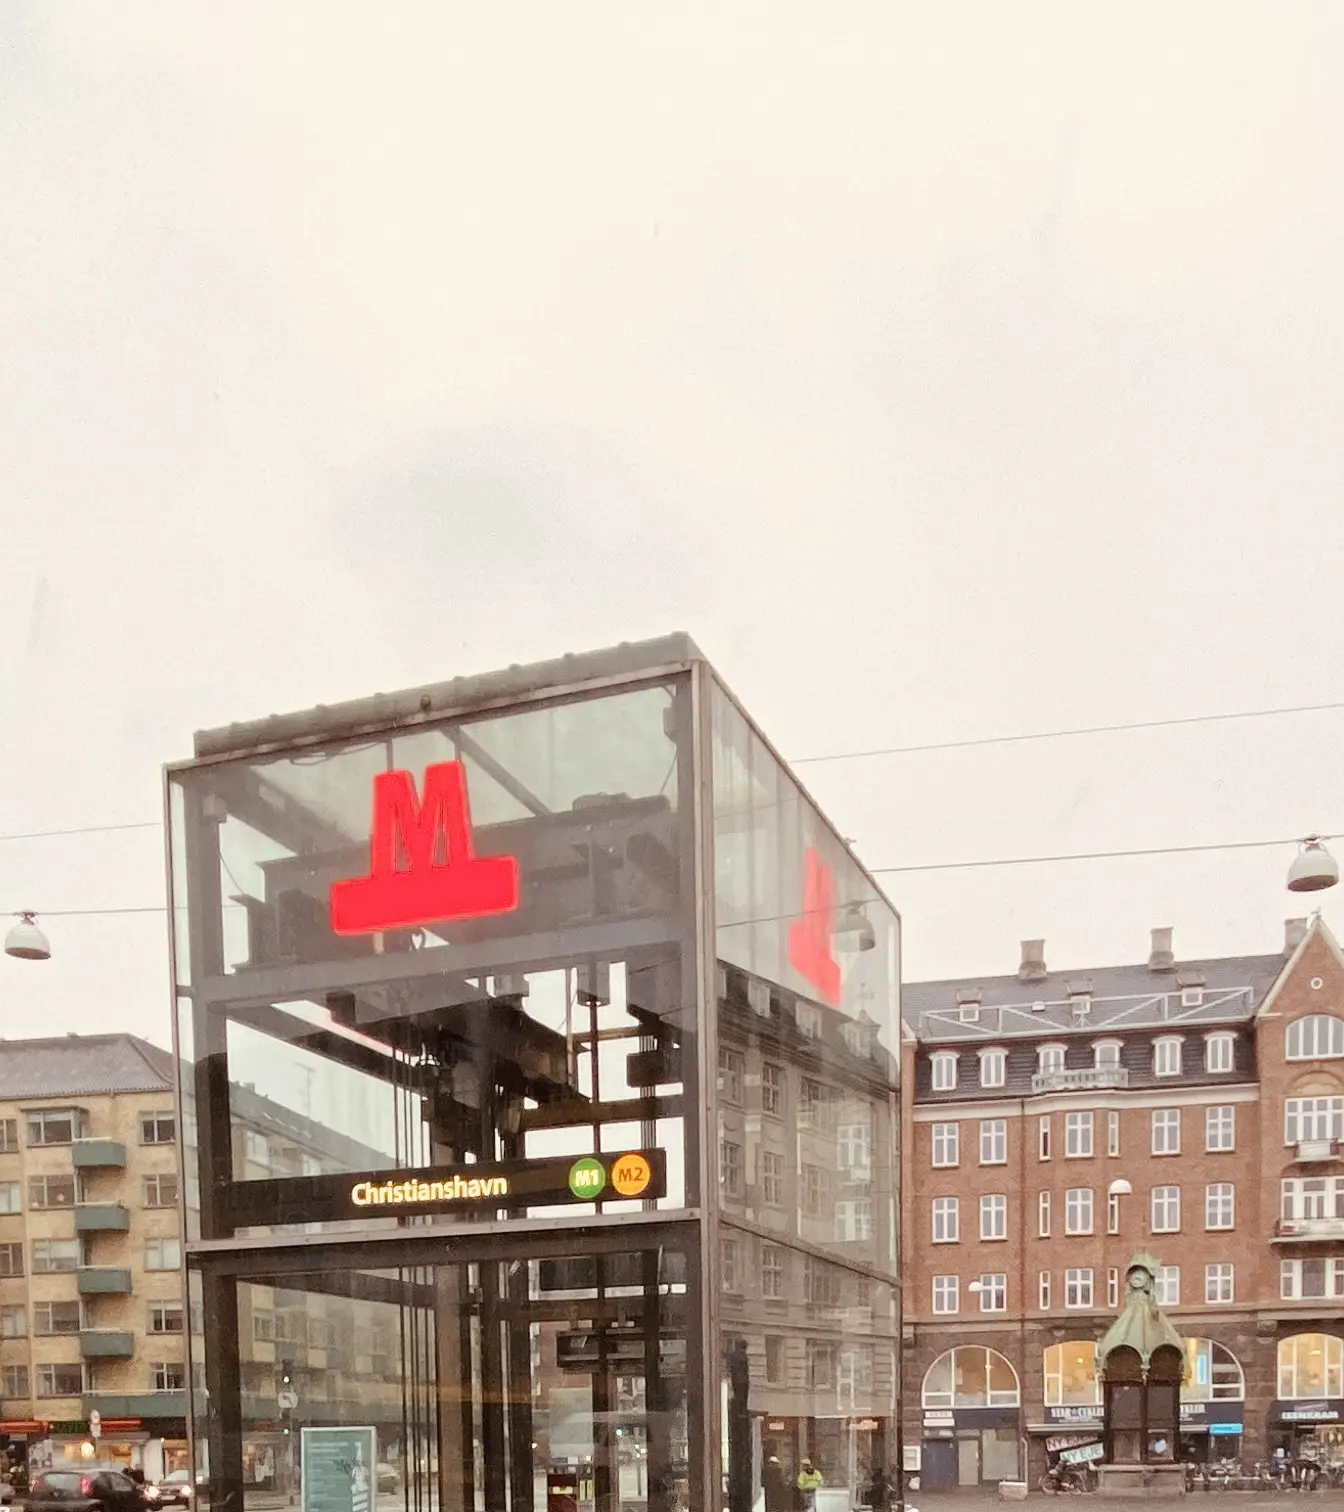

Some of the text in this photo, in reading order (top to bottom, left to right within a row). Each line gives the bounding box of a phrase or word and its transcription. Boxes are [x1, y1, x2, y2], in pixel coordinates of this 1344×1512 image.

[575, 1168, 599, 1188] M1
[618, 1167, 643, 1184] M2
[352, 1175, 507, 1206] Christianshavn
